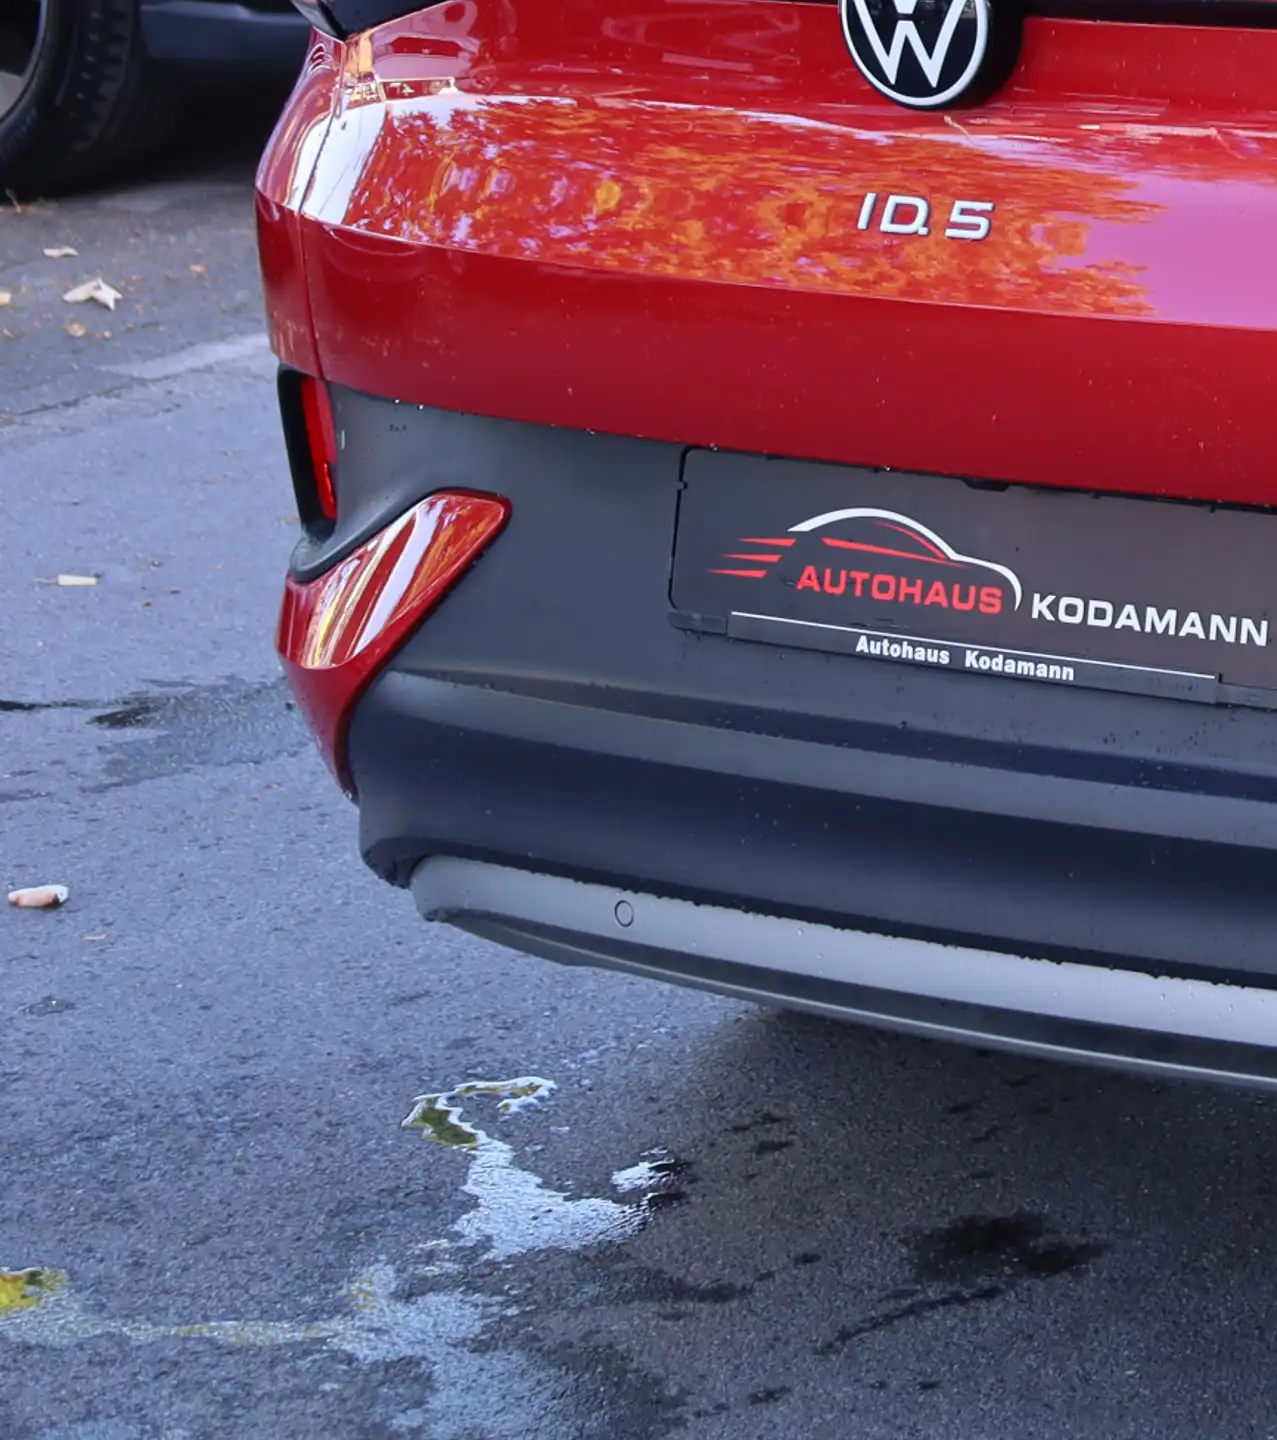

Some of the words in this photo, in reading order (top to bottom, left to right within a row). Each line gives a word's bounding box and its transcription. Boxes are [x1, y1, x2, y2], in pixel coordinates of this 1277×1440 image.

[797, 565, 1003, 614] AUTOHAUS
[1031, 593, 1269, 647] KODAMANN
[855, 634, 950, 664] Autohaus
[965, 649, 1075, 681] Kodamann
